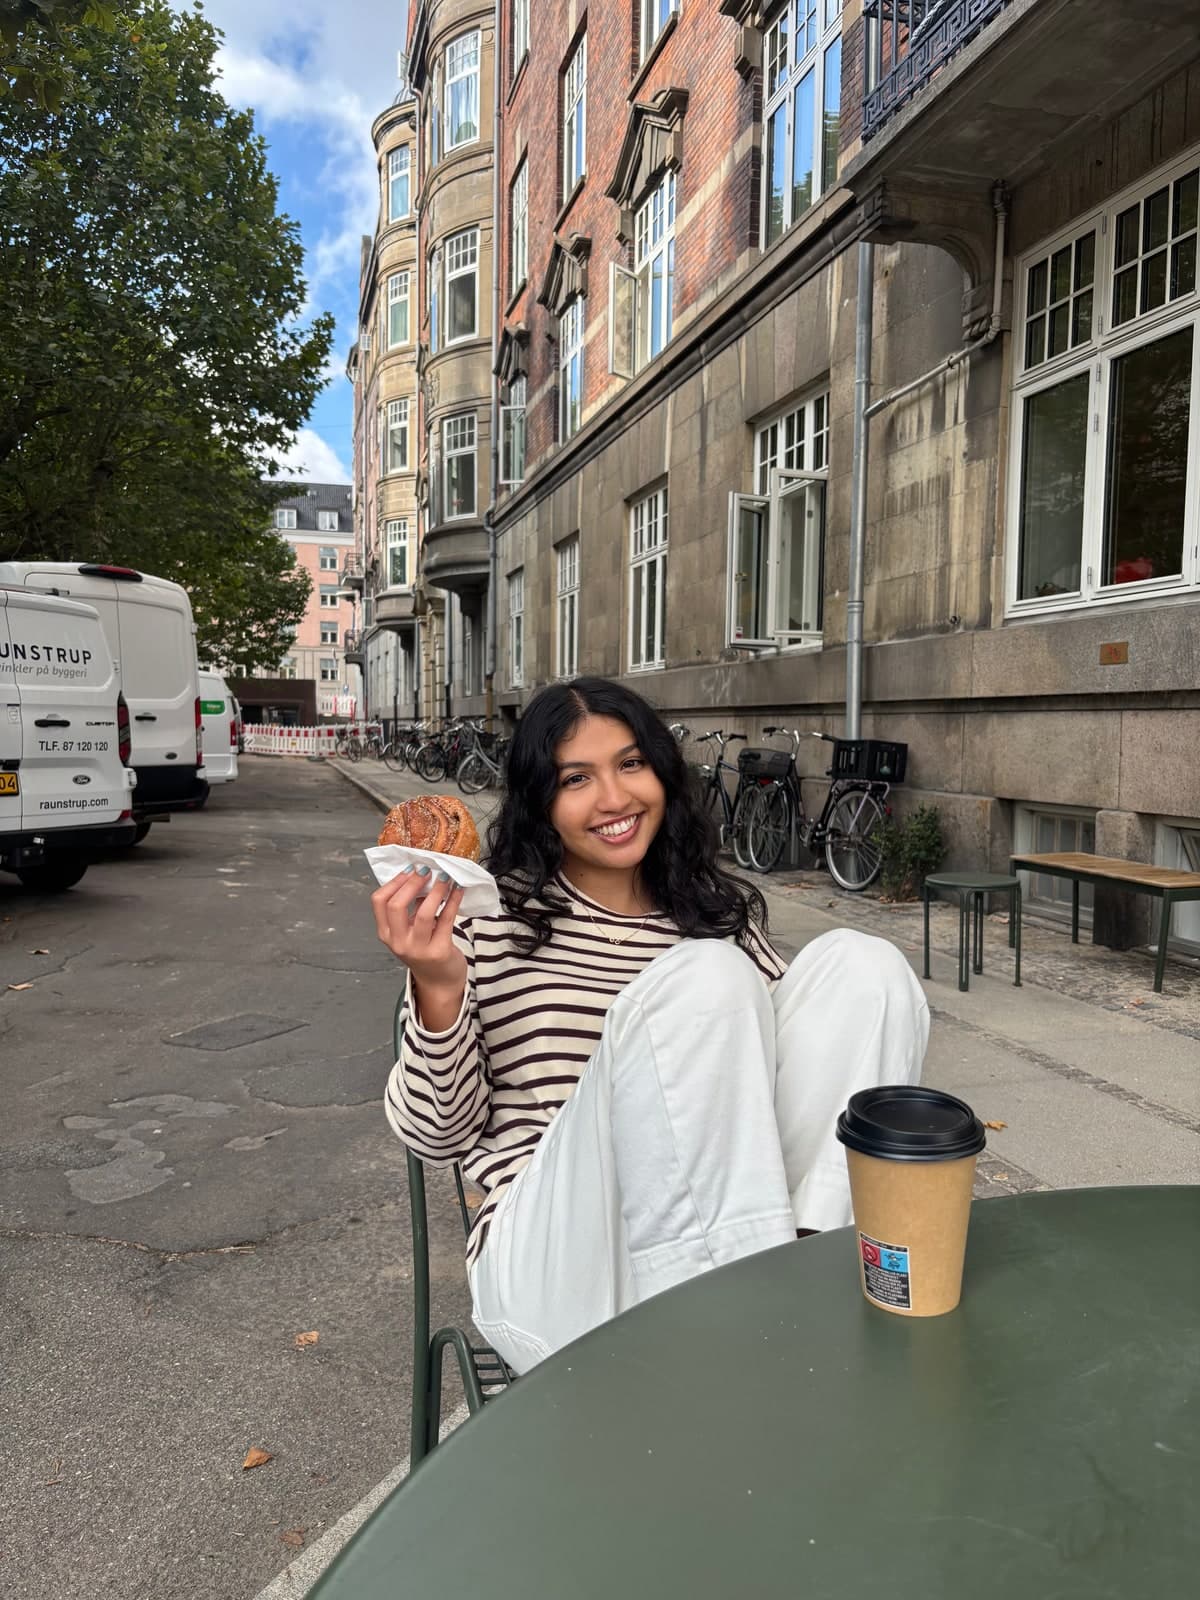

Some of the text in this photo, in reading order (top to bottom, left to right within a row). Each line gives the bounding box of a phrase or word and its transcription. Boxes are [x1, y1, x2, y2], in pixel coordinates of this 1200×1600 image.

[0, 642, 92, 665] UNSTRUP
[0, 662, 88, 679] inkler på byggeri
[39, 740, 109, 752] TLF. 87 120 120
[39, 798, 109, 811] raunstrup.com
